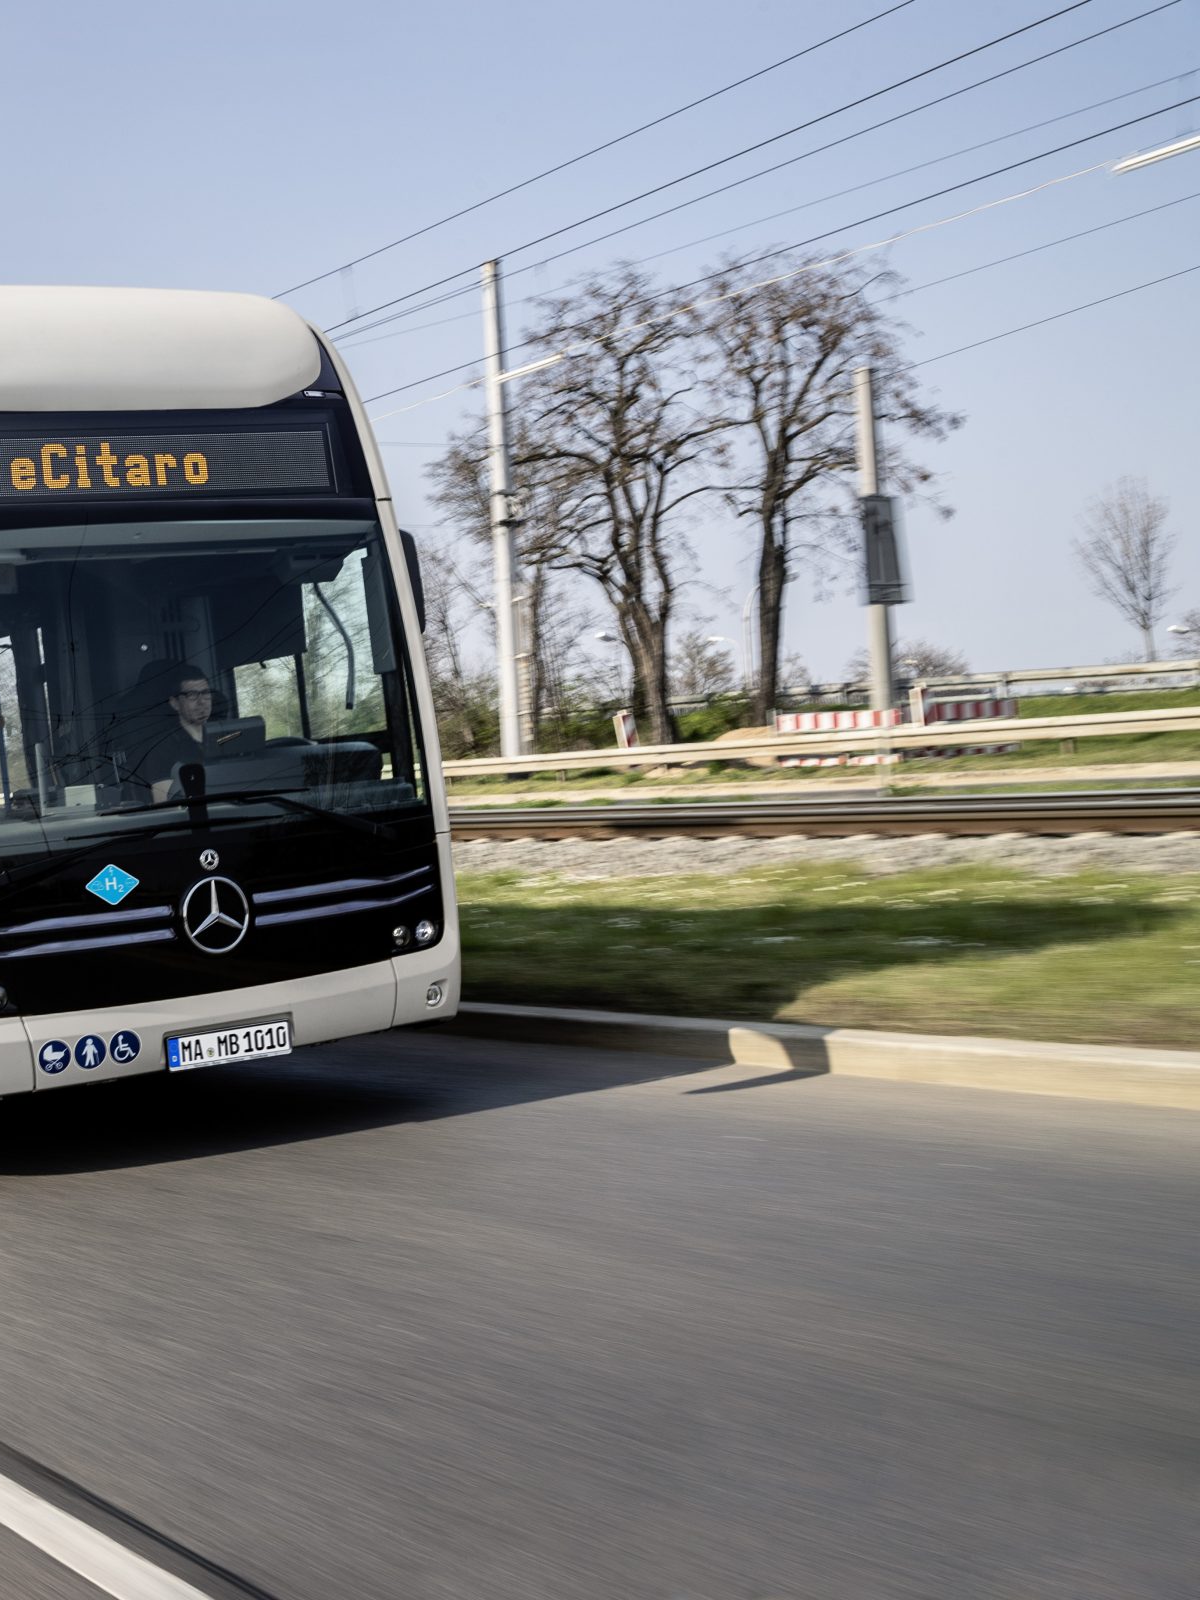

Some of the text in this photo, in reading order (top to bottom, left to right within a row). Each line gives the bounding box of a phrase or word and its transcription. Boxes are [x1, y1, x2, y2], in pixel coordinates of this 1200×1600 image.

[10, 442, 209, 490] eCitaro
[181, 1039, 204, 1062] MA
[217, 1033, 240, 1057] MB
[243, 1026, 287, 1053] 1010
